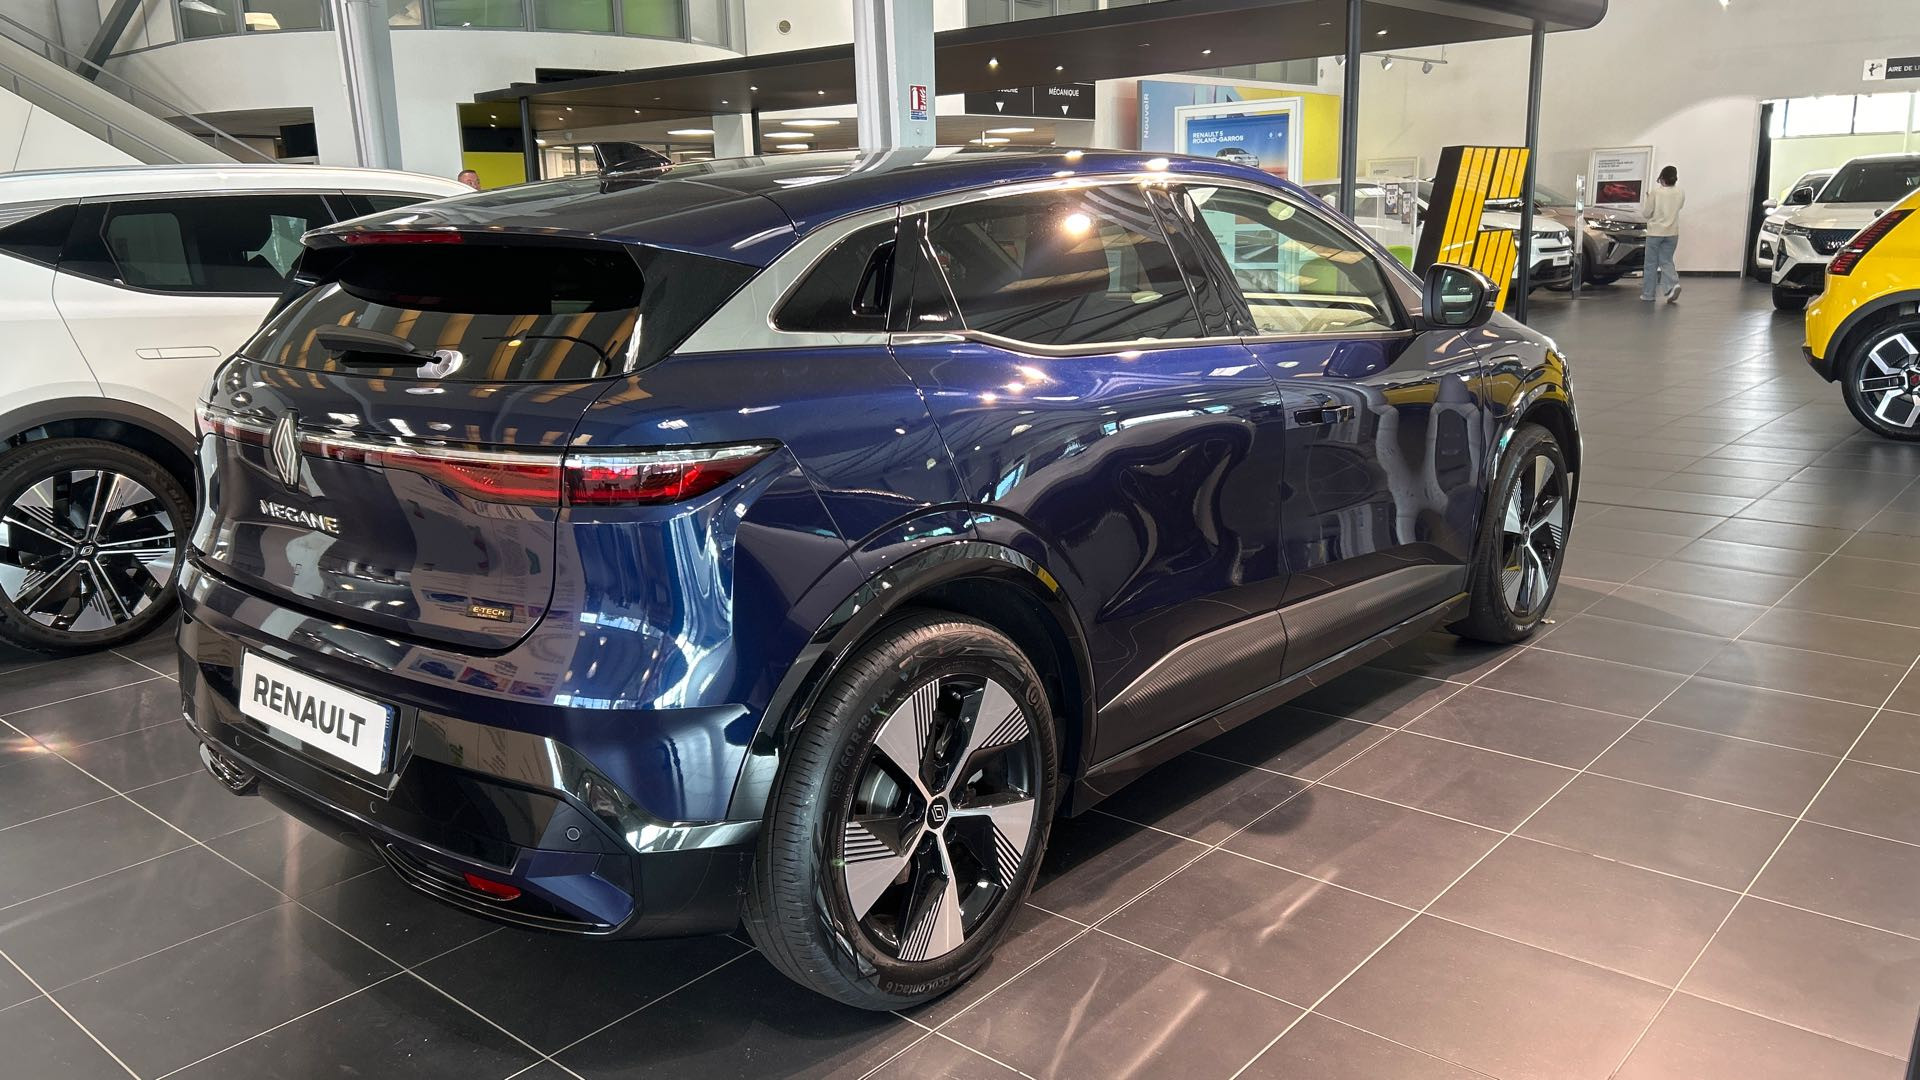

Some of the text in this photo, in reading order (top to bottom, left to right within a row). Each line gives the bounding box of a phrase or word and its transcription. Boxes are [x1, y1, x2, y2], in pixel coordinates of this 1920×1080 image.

[1048, 86, 1080, 97] MÉCANIQUE
[1192, 131, 1219, 139] RENAULT
[1192, 135, 1244, 144] ROLAND-GARROS
[260, 499, 339, 535] MEGANE
[472, 606, 505, 617] E-TECH
[253, 673, 367, 748] RENAULT
